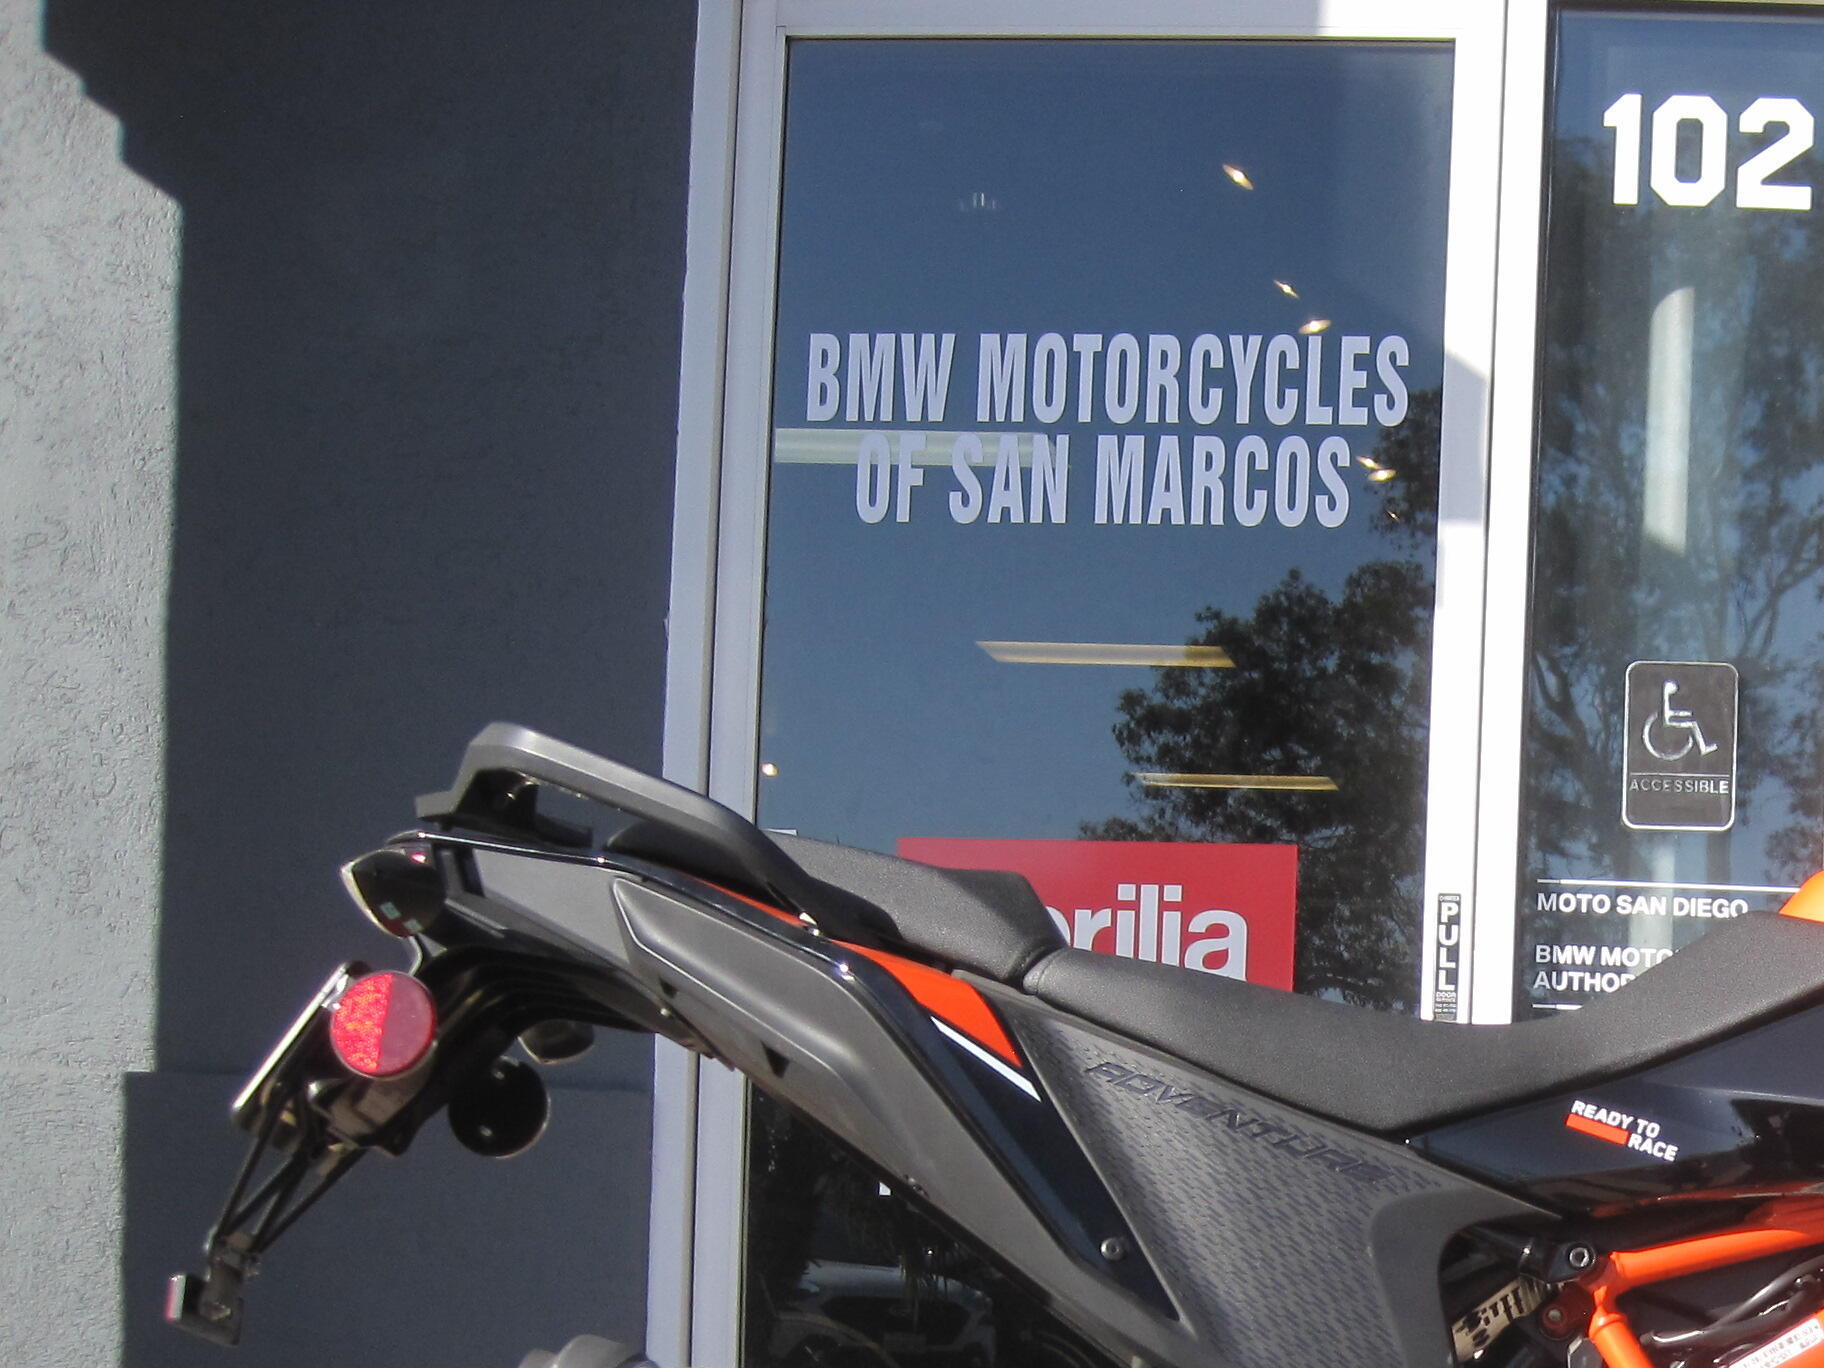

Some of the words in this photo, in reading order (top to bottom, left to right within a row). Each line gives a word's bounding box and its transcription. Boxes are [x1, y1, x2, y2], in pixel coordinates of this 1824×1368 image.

[1603, 93, 1815, 210] 102
[806, 332, 956, 423] BMW
[977, 332, 1411, 427] MOTORCYCLES
[855, 431, 927, 525] OF
[948, 433, 1071, 525] SAN
[1093, 434, 1352, 529] MARCOS
[1628, 777, 1730, 796] ACCESSIBLE
[1045, 883, 1249, 982] rilia
[1438, 901, 1460, 991] PULL
[1536, 892, 1611, 914] MOTO
[1616, 894, 1667, 916] SAN
[1672, 896, 1750, 919] DIEGO
[1535, 944, 1597, 966] BMW
[1600, 945, 1680, 968] MOTO
[1085, 1060, 1398, 1186] ADVENTURE
[1569, 1100, 1635, 1137] READY
[1634, 1117, 1661, 1138] TO
[1627, 1132, 1679, 1163] RACE
